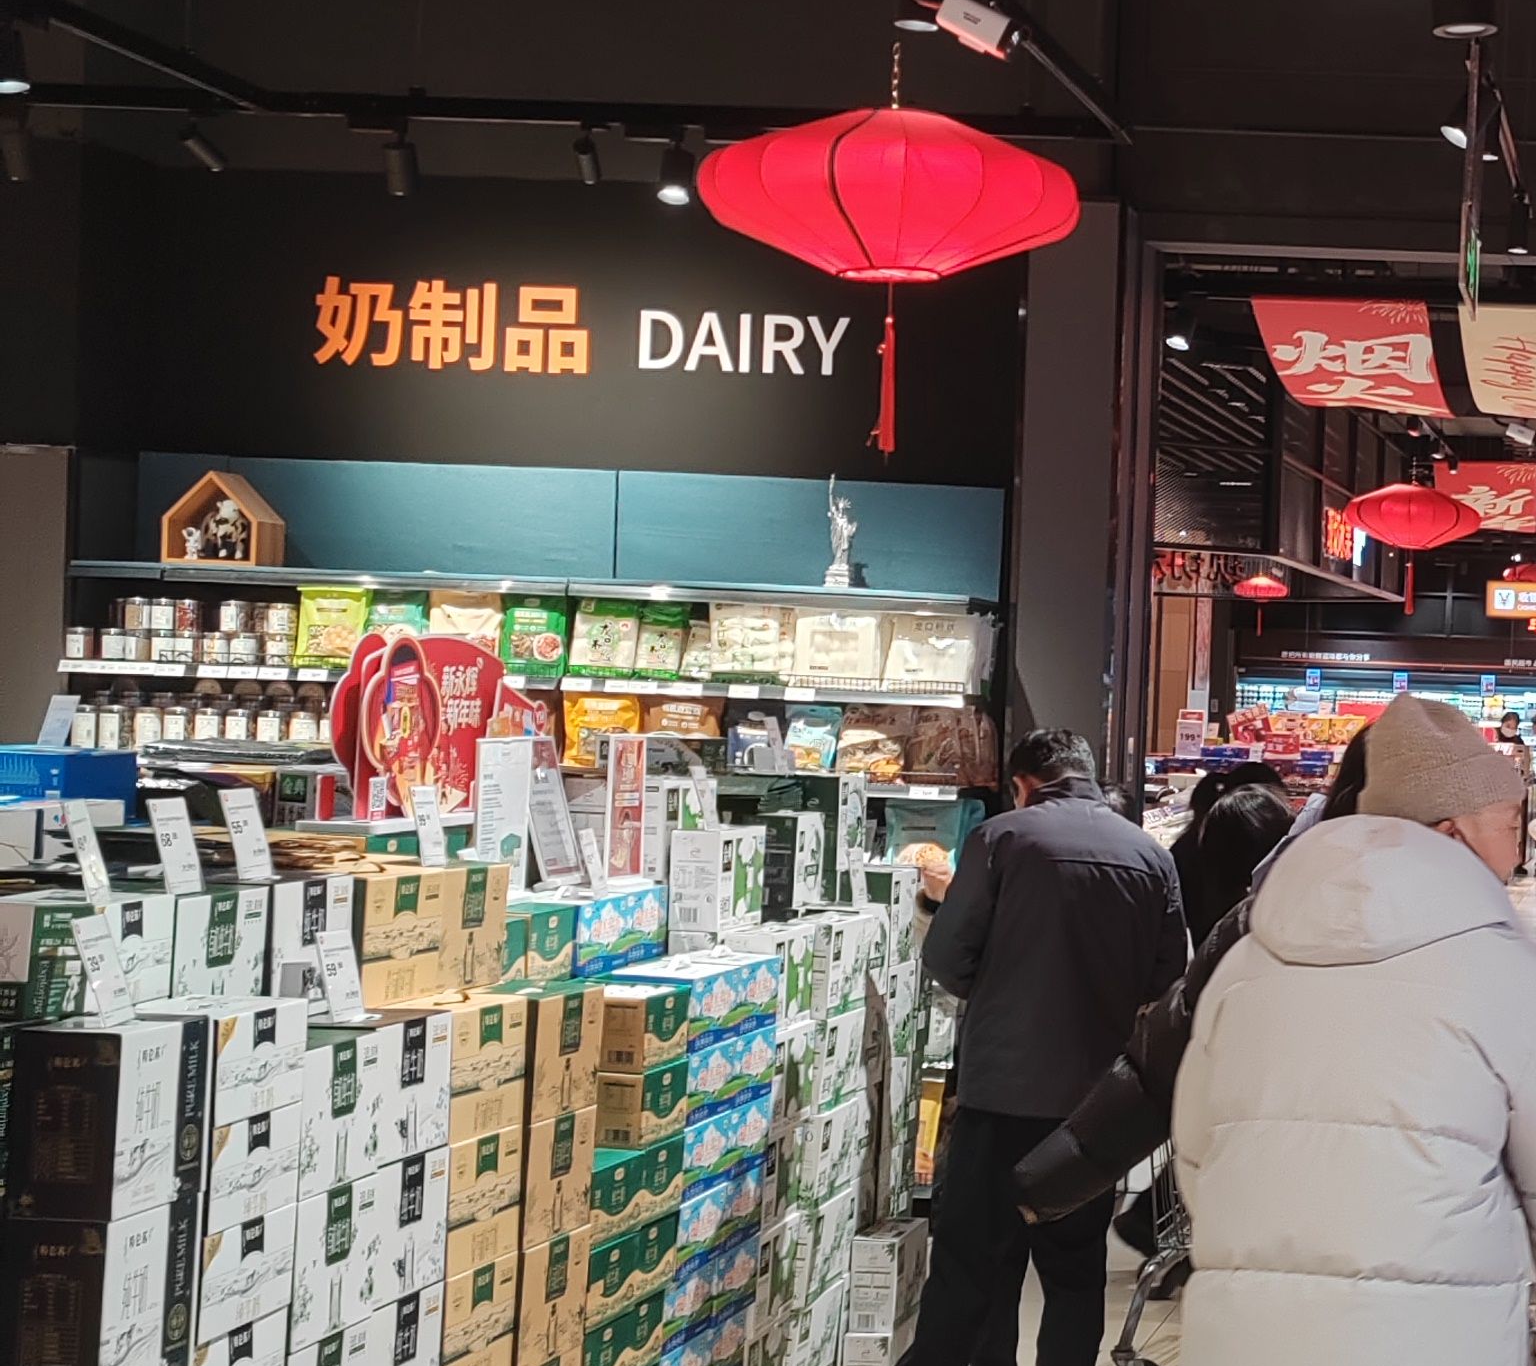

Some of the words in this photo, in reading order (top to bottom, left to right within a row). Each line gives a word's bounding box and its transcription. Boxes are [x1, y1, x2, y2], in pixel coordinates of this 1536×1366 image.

[313, 273, 591, 377] 奶制品
[636, 308, 852, 377] DAIRY
[441, 664, 479, 698] 新永辉
